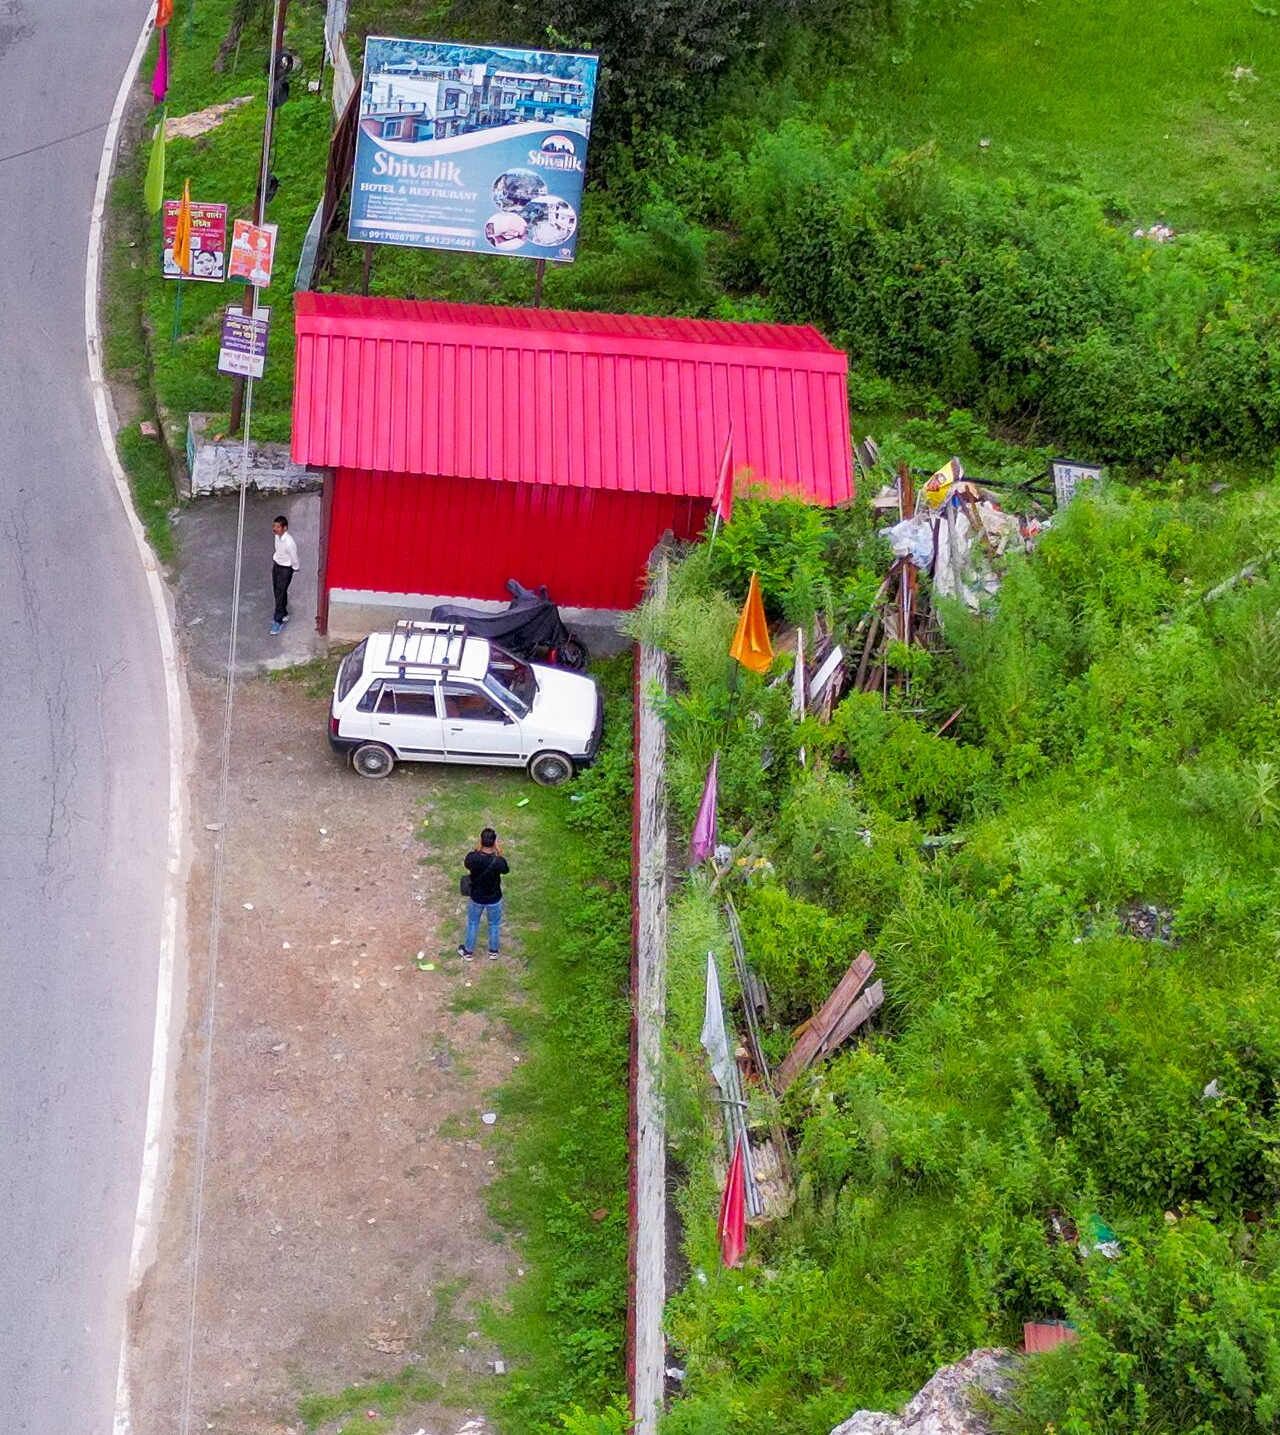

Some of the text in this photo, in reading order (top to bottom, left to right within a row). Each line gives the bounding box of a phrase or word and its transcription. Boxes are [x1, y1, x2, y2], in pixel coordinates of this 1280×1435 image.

[372, 151, 465, 186] Shivalik
[527, 150, 584, 172] Shivalik
[360, 182, 478, 201] HOTEL & RESTAURANT
